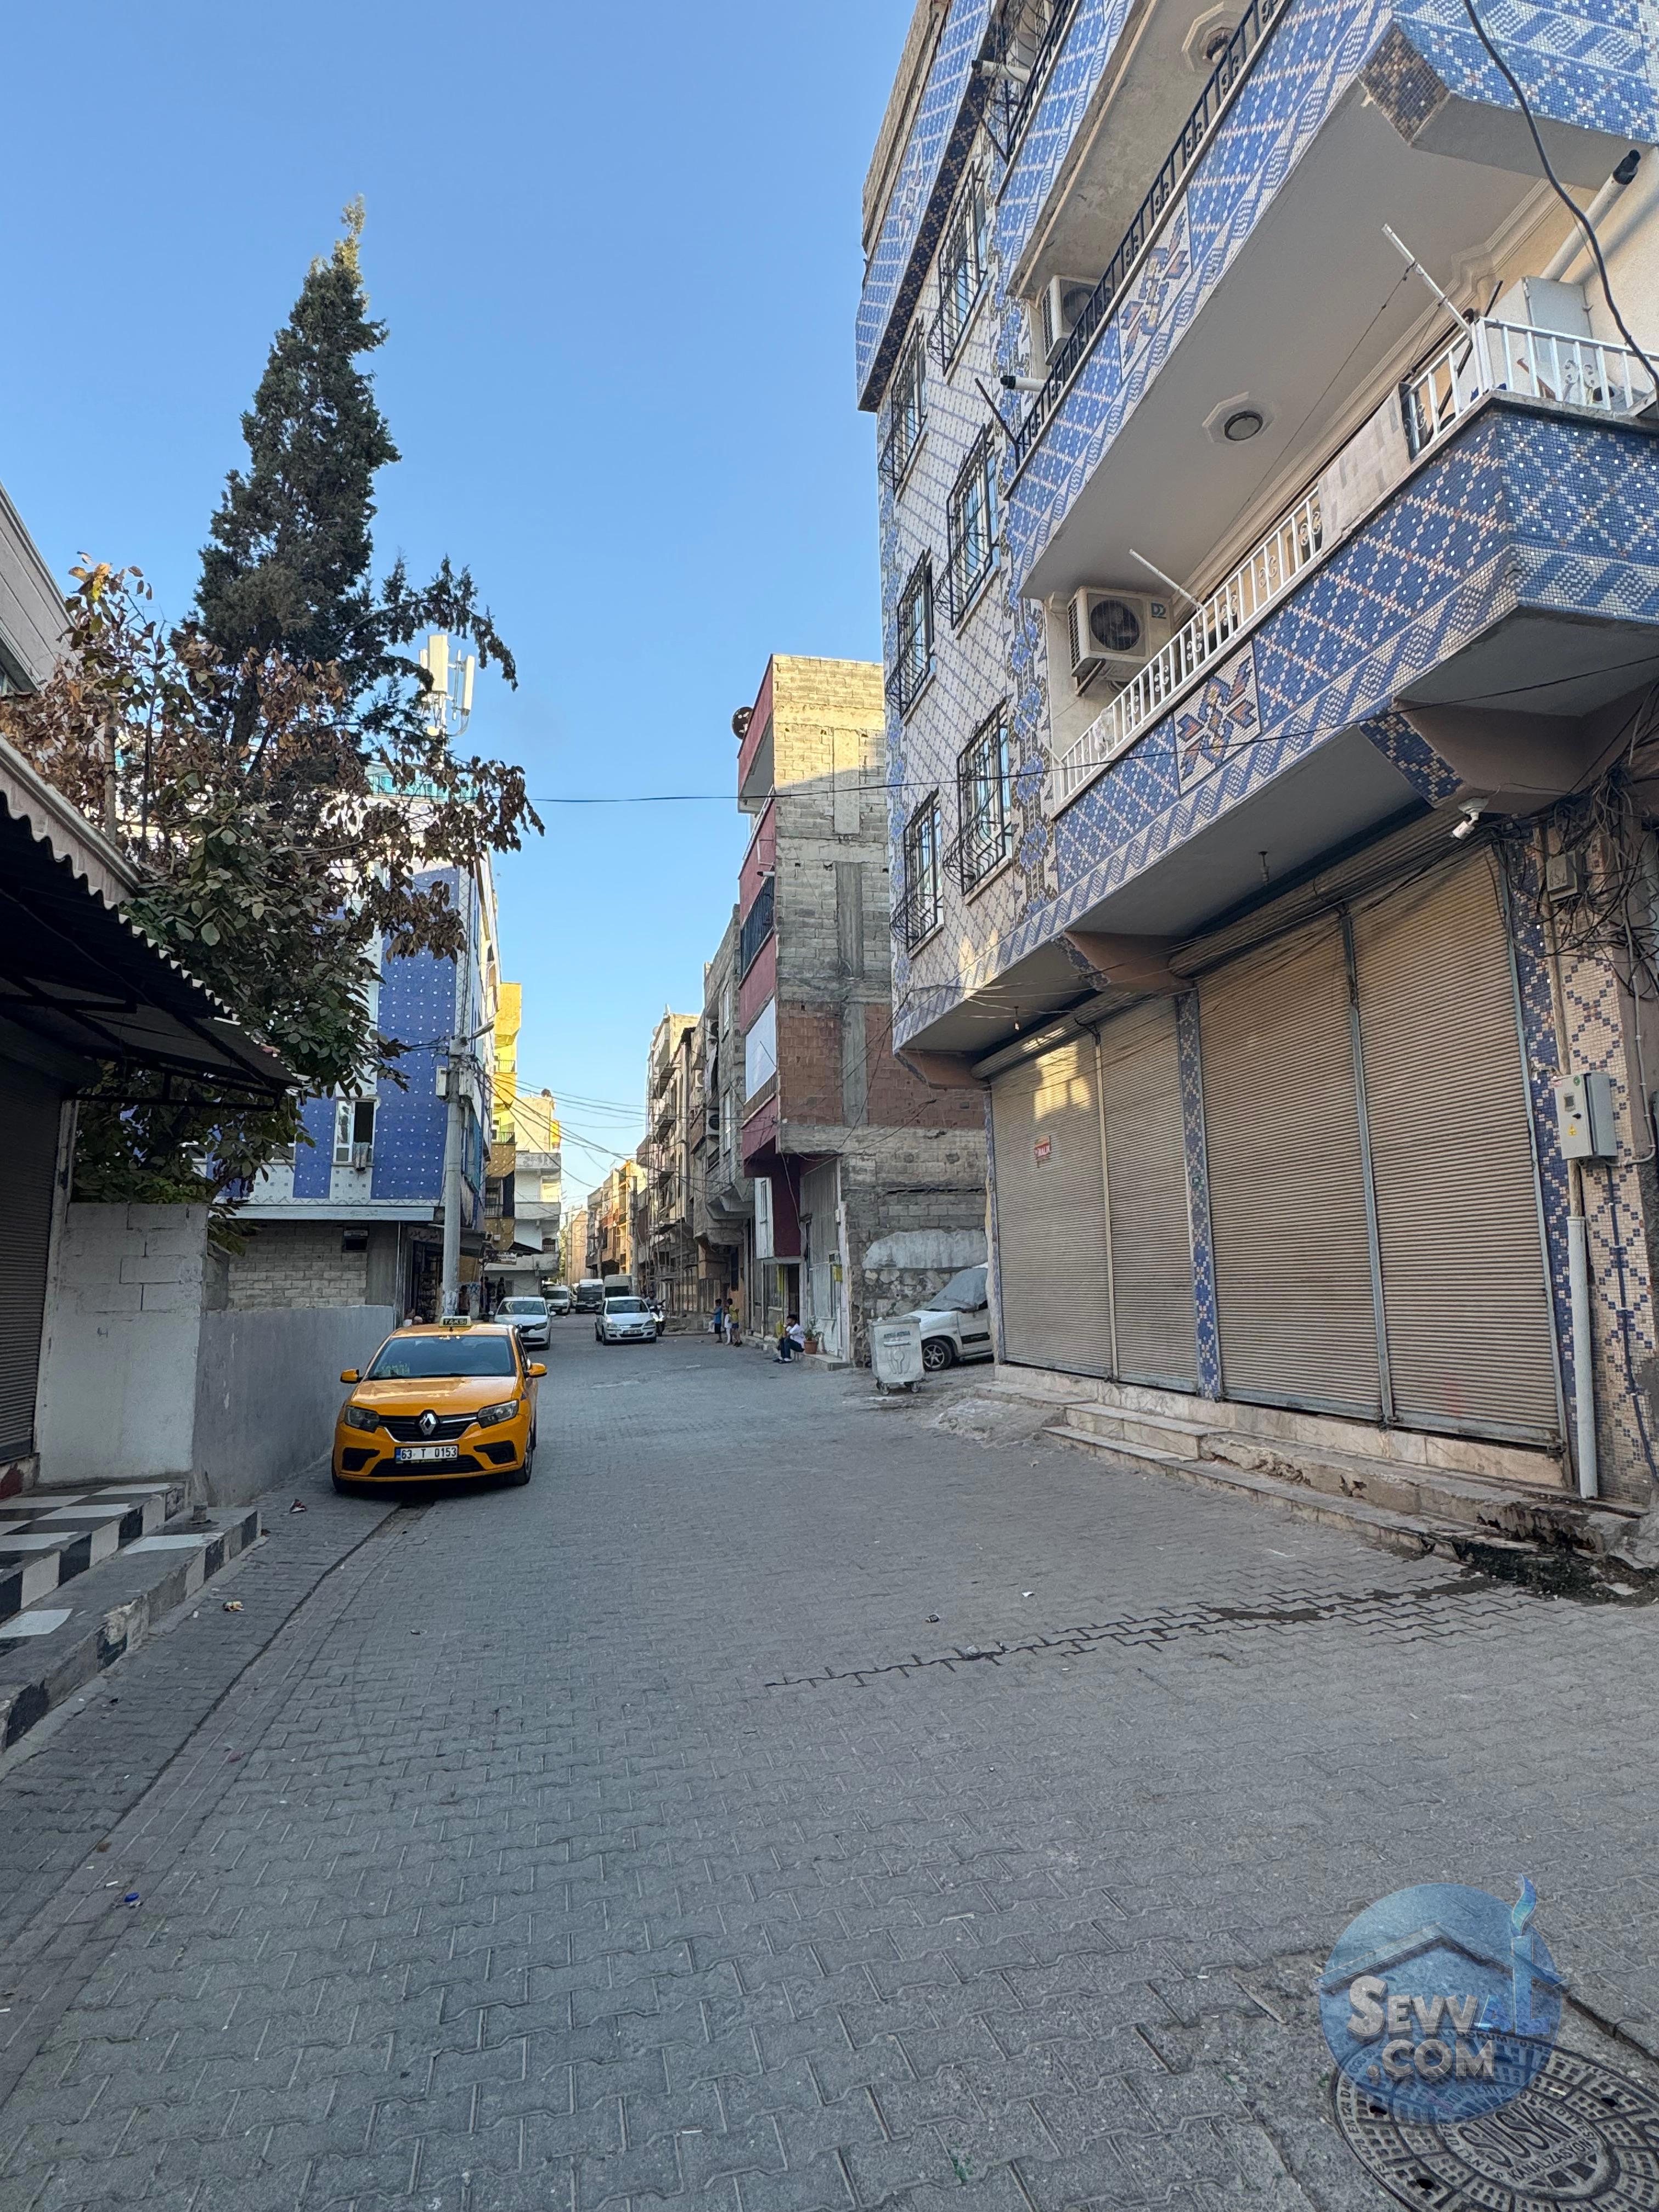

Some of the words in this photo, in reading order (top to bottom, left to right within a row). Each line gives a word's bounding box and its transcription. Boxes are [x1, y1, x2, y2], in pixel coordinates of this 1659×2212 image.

[402, 1449, 413, 1459] 63
[421, 1448, 426, 1458] T
[435, 1447, 456, 1458] 0153
